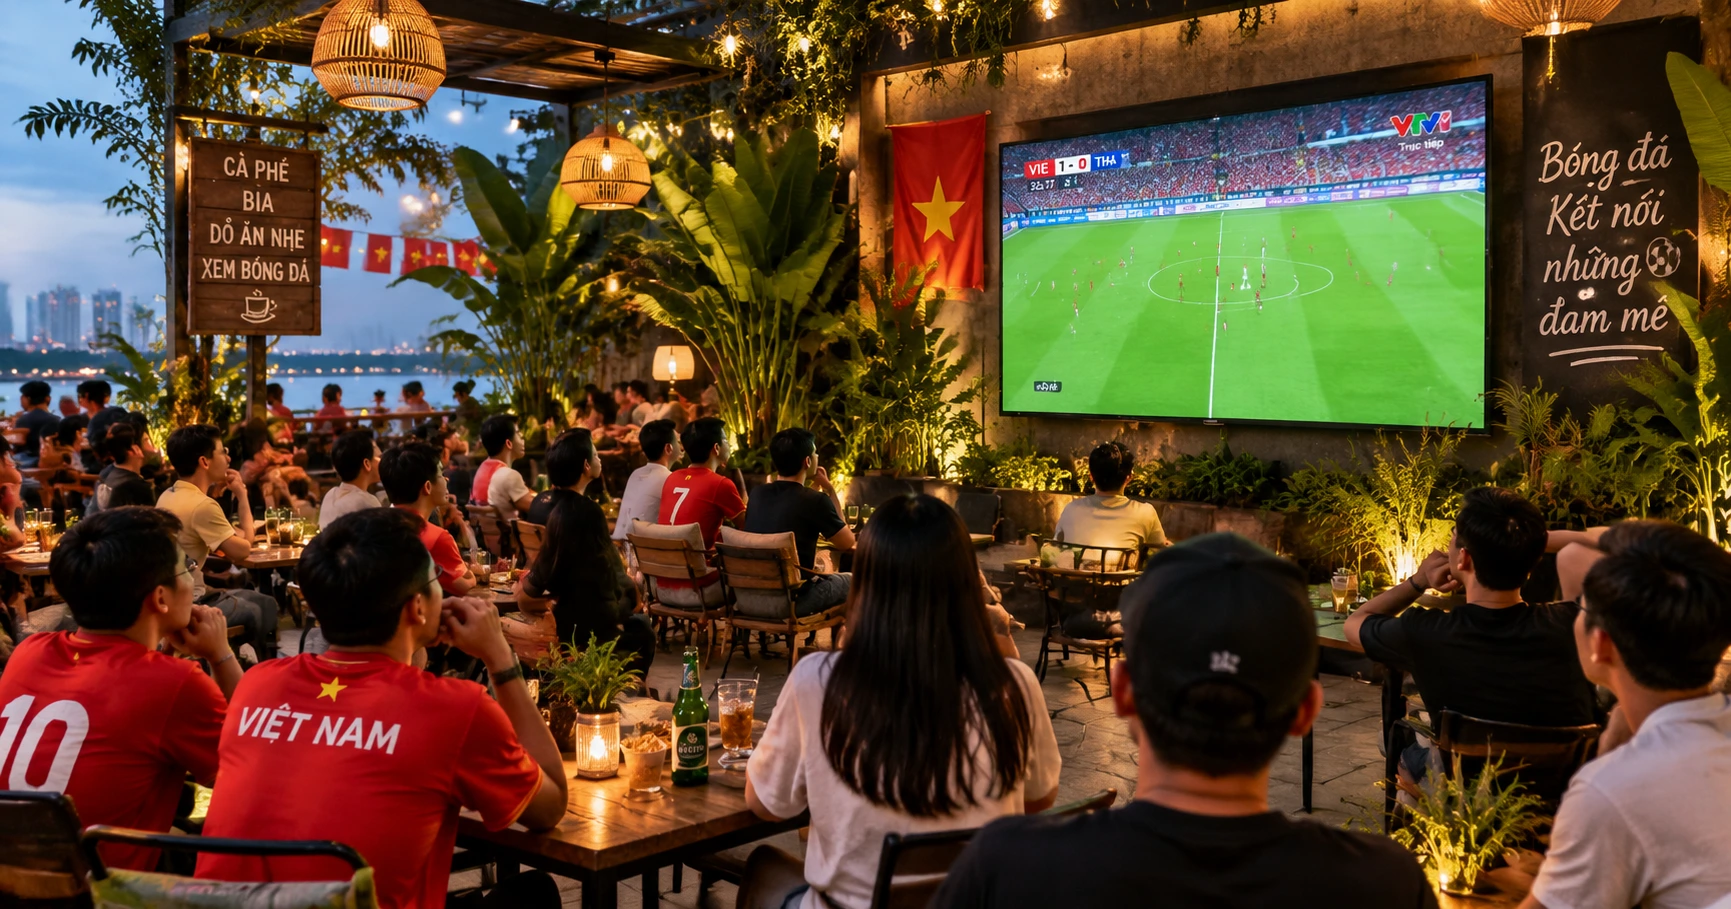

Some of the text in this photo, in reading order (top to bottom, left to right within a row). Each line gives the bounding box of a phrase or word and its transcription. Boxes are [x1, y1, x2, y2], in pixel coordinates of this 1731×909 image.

[223, 151, 249, 178] CÀ
[1028, 162, 1049, 175] VIE
[1538, 131, 1673, 191] Bóng đá
[201, 257, 236, 280] XEM
[669, 486, 690, 526] 7
[0, 694, 90, 796] 10
[237, 702, 401, 755] VIỆT NAM
